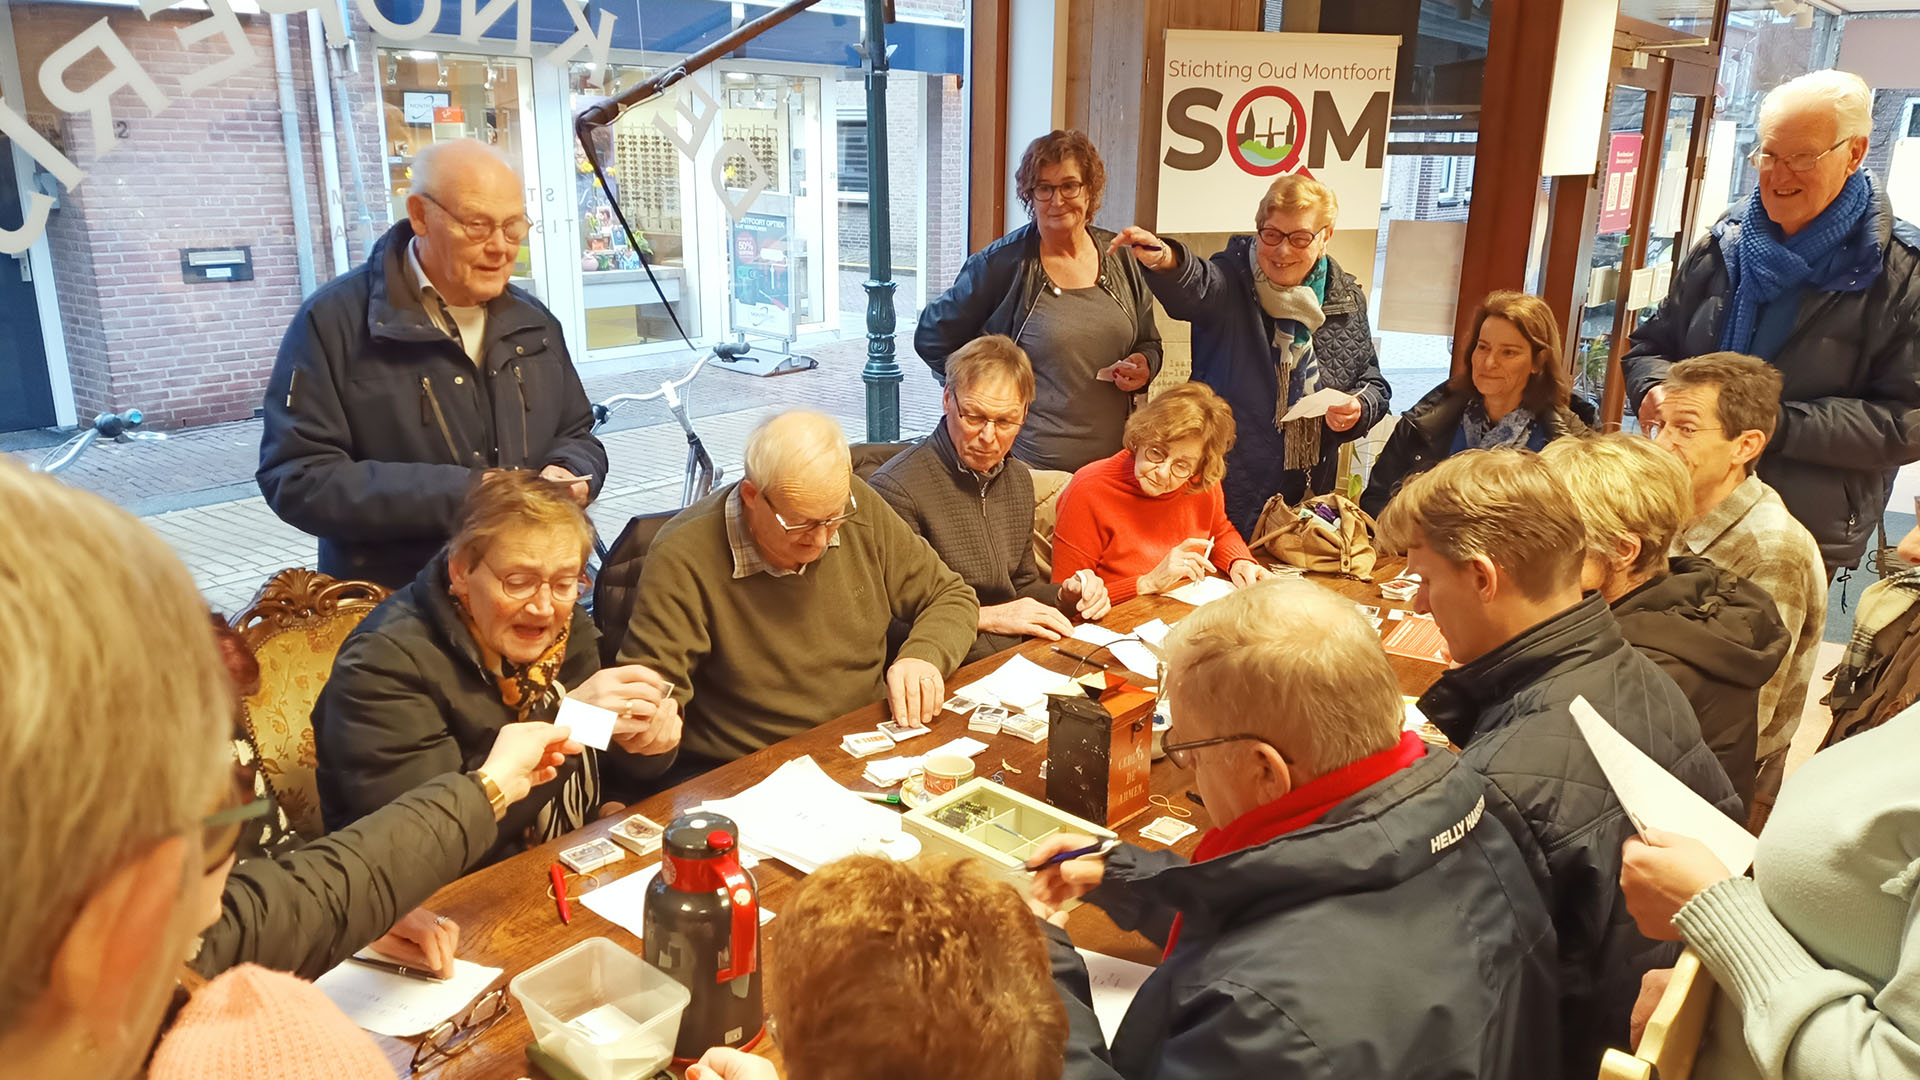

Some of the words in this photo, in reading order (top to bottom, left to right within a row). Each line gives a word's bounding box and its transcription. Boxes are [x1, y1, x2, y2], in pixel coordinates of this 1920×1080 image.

[1168, 59, 1252, 82] Stichting
[1257, 61, 1297, 80] Oud
[1303, 62, 1392, 81] Montfoort
[738, 240, 754, 251] 50%
[1430, 819, 1465, 854] HELLY
